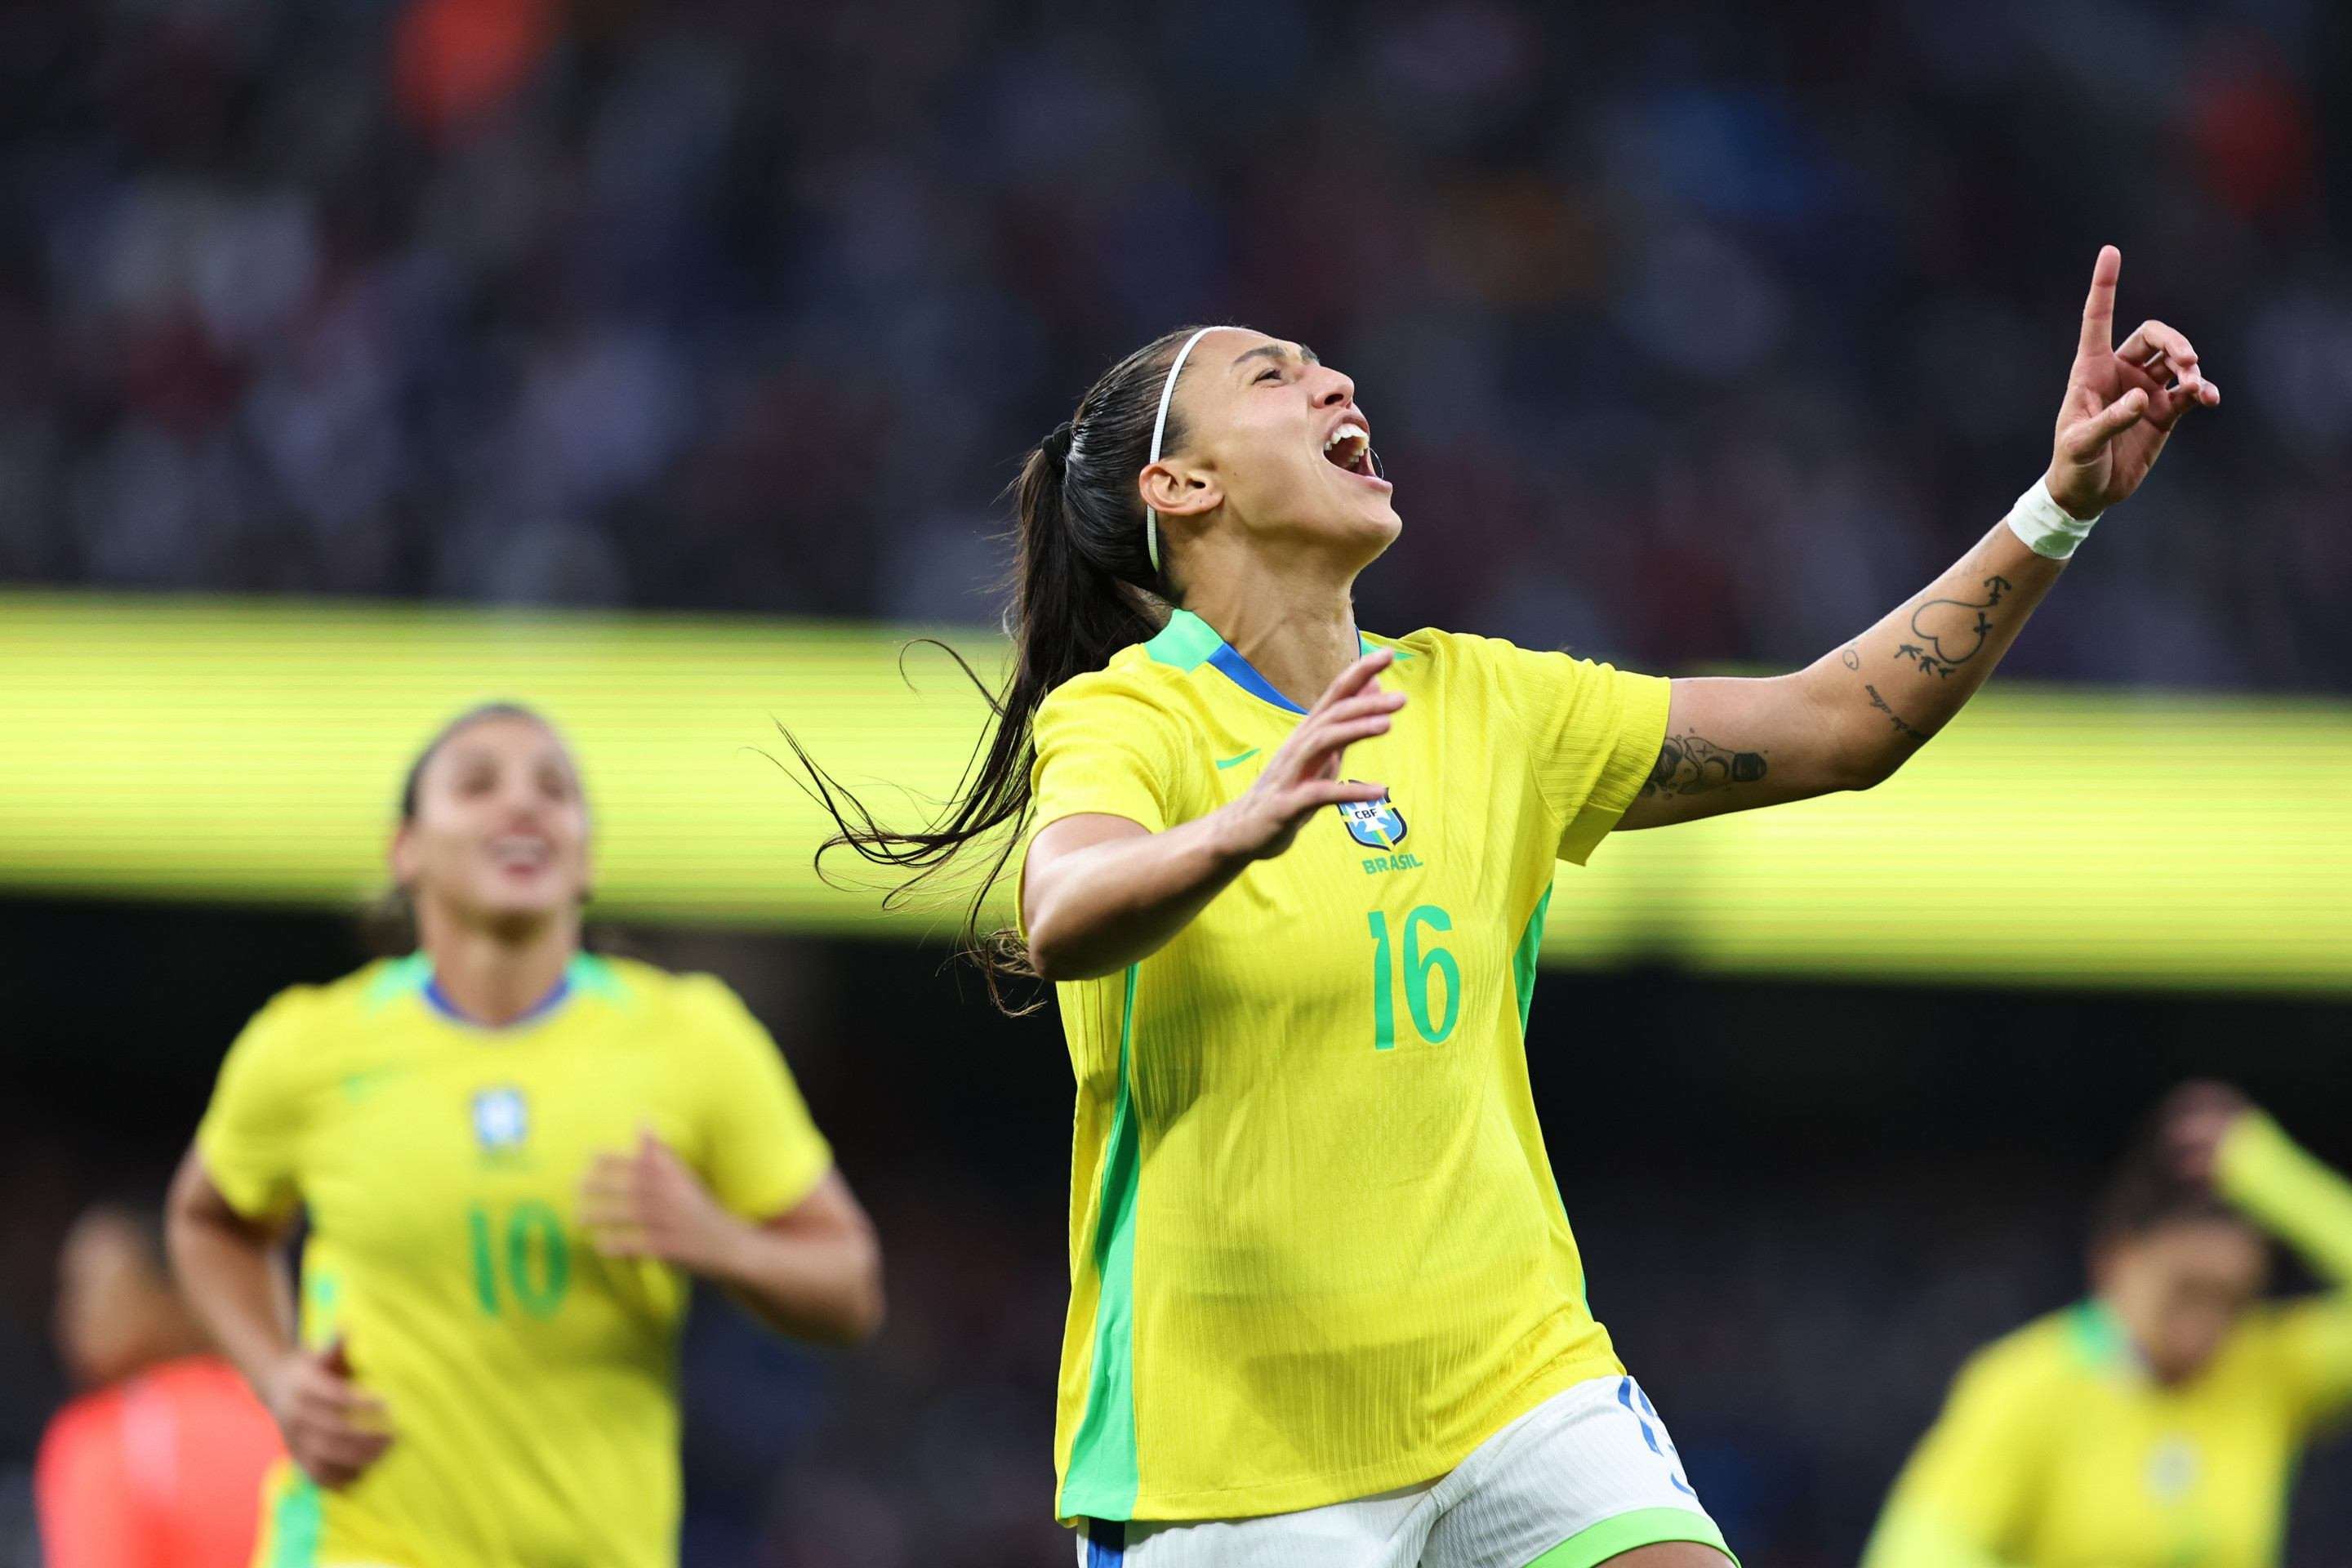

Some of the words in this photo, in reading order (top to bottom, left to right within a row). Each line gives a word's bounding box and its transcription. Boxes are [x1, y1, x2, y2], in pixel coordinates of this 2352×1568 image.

[1354, 808, 1378, 820] CBF
[1361, 853, 1423, 875] BRASIL
[1367, 904, 1461, 1050] 16
[468, 1201, 570, 1322] 10
